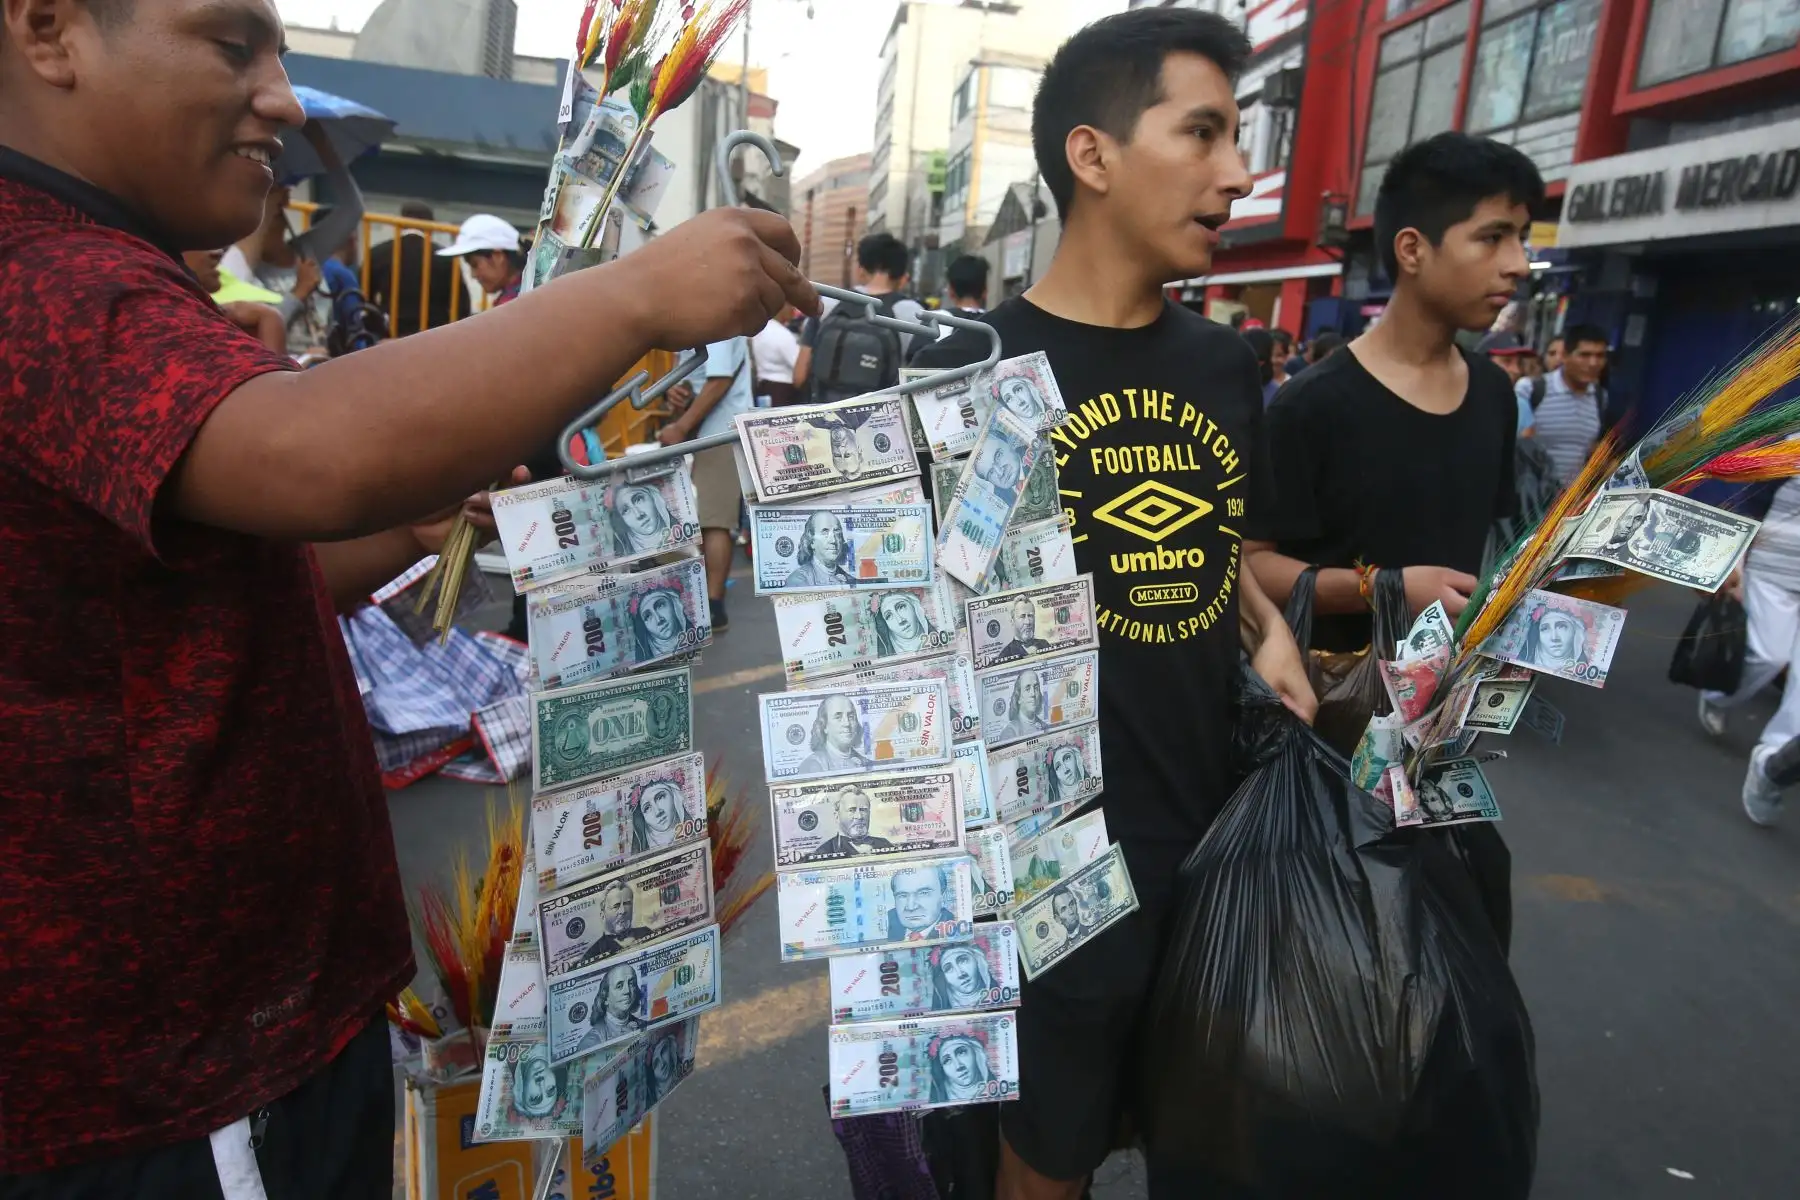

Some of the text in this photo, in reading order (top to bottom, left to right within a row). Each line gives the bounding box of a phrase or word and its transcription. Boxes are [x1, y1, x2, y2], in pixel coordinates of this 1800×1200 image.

[1039, 407, 1065, 426] 200
[1123, 388, 1174, 423] THE
[1179, 402, 1240, 474] PITCH
[1090, 444, 1201, 475] FOOTBALL
[896, 508, 920, 516] 100
[526, 522, 539, 541] VALOR
[551, 509, 580, 549] 200
[661, 522, 694, 545] 200
[1110, 545, 1205, 574] umbro
[763, 579, 786, 588] 100
[1178, 543, 1239, 640] SPORTSWEAR
[1136, 587, 1192, 602] MCMXXIV
[583, 617, 605, 657] 200
[676, 626, 705, 647] 200
[824, 612, 846, 647] 200
[558, 631, 572, 652] VALOR
[920, 631, 949, 649] 200
[1083, 664, 1093, 694] VALOR
[1564, 661, 1599, 680] 200
[592, 711, 645, 746] ONE
[921, 693, 937, 746] SIN VALOR
[924, 775, 951, 784] 50
[1016, 766, 1029, 798] 200
[1078, 776, 1098, 792] 200
[576, 787, 600, 799] CENTRAL
[545, 811, 570, 856] SIN VALOR
[582, 811, 602, 850] 200
[674, 818, 703, 840] 200
[778, 850, 801, 865] 50
[871, 843, 931, 854] DOLLARS
[805, 876, 825, 885] BANCO
[974, 890, 1008, 910] 200
[801, 902, 818, 920] VALOR
[935, 920, 969, 939] 100
[851, 968, 867, 985] VALOR
[880, 961, 900, 997] 200
[517, 982, 537, 1001] VALOR
[978, 987, 1012, 1005] 200
[878, 1052, 899, 1088] 200
[976, 1080, 1010, 1097] 200
